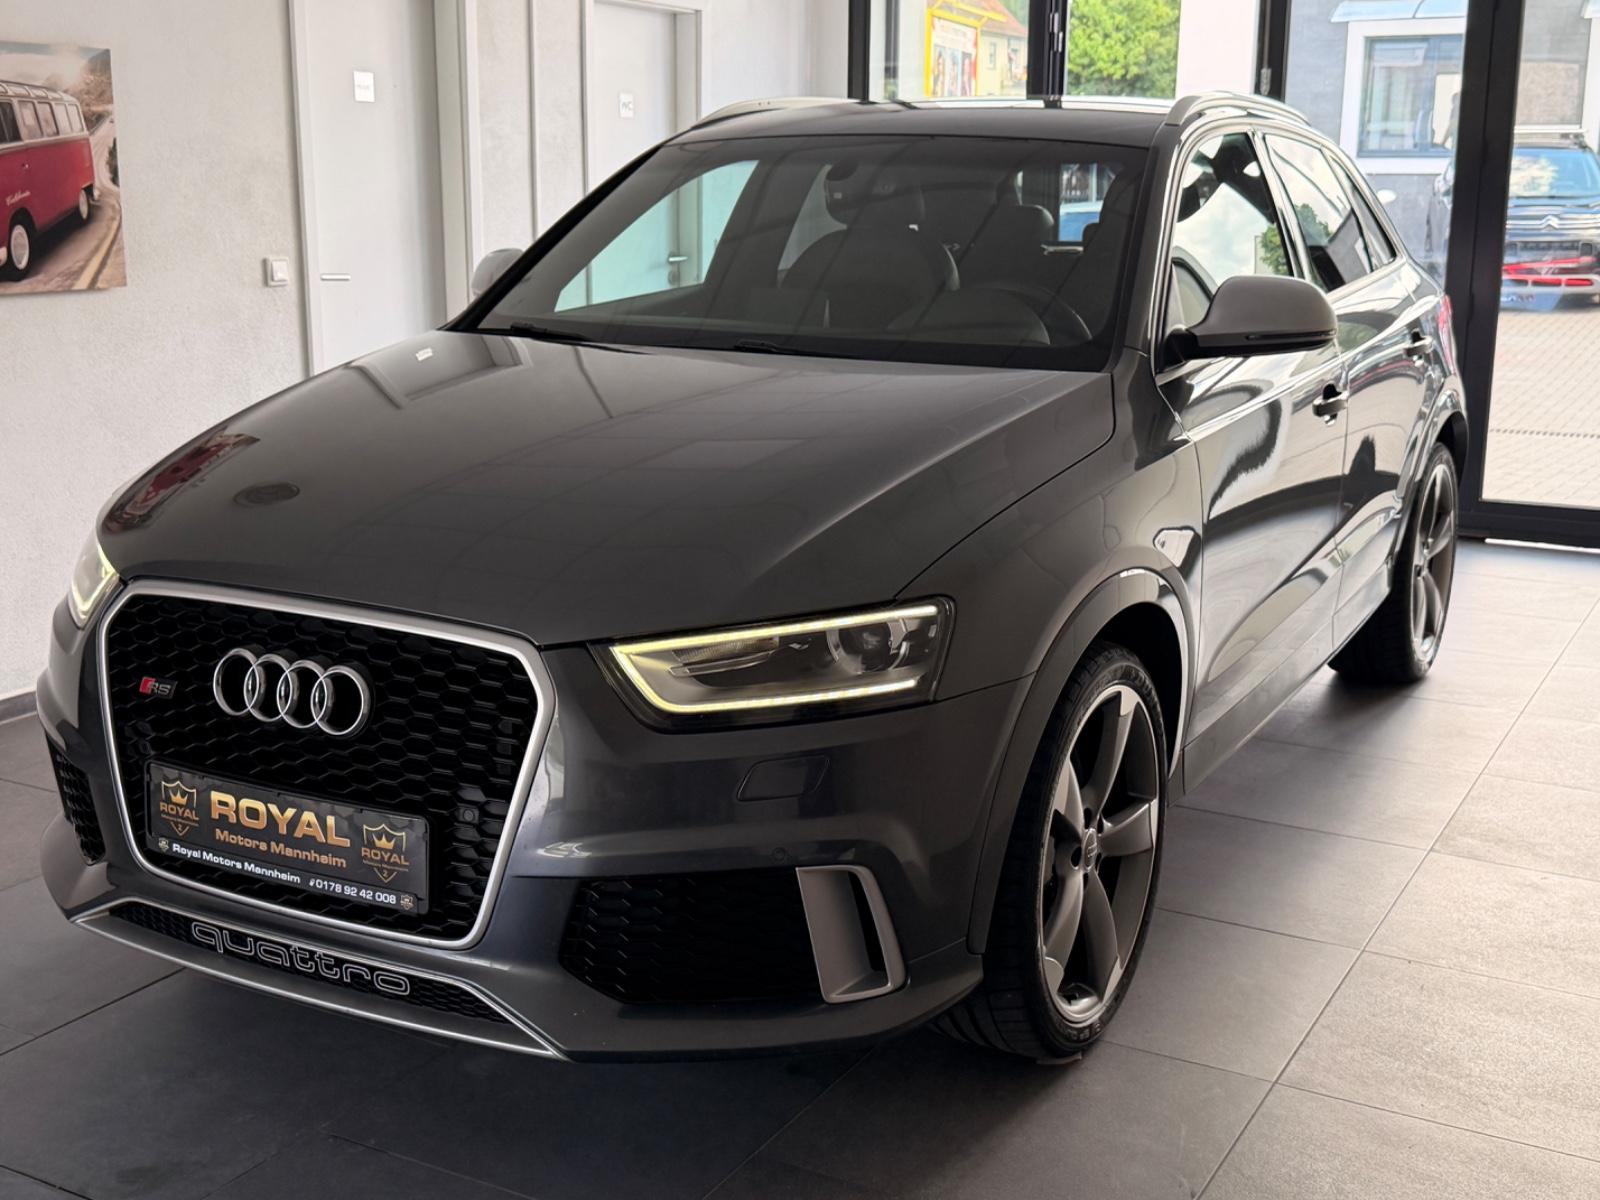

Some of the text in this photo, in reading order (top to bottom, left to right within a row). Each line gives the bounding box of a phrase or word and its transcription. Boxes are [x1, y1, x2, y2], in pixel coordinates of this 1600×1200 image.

[140, 678, 172, 697] RS
[160, 802, 199, 821] ROYAL
[210, 791, 350, 848] ROYAL
[215, 829, 268, 852] Motors
[270, 840, 346, 868] Mannheim
[361, 846, 410, 866] ROYAL
[172, 843, 201, 860] Royal
[202, 851, 242, 870] Motors
[244, 862, 301, 884] Mannheim
[343, 885, 357, 896] 92
[359, 889, 373, 900] 42
[375, 892, 397, 905] 008
[191, 921, 411, 996] quattro
